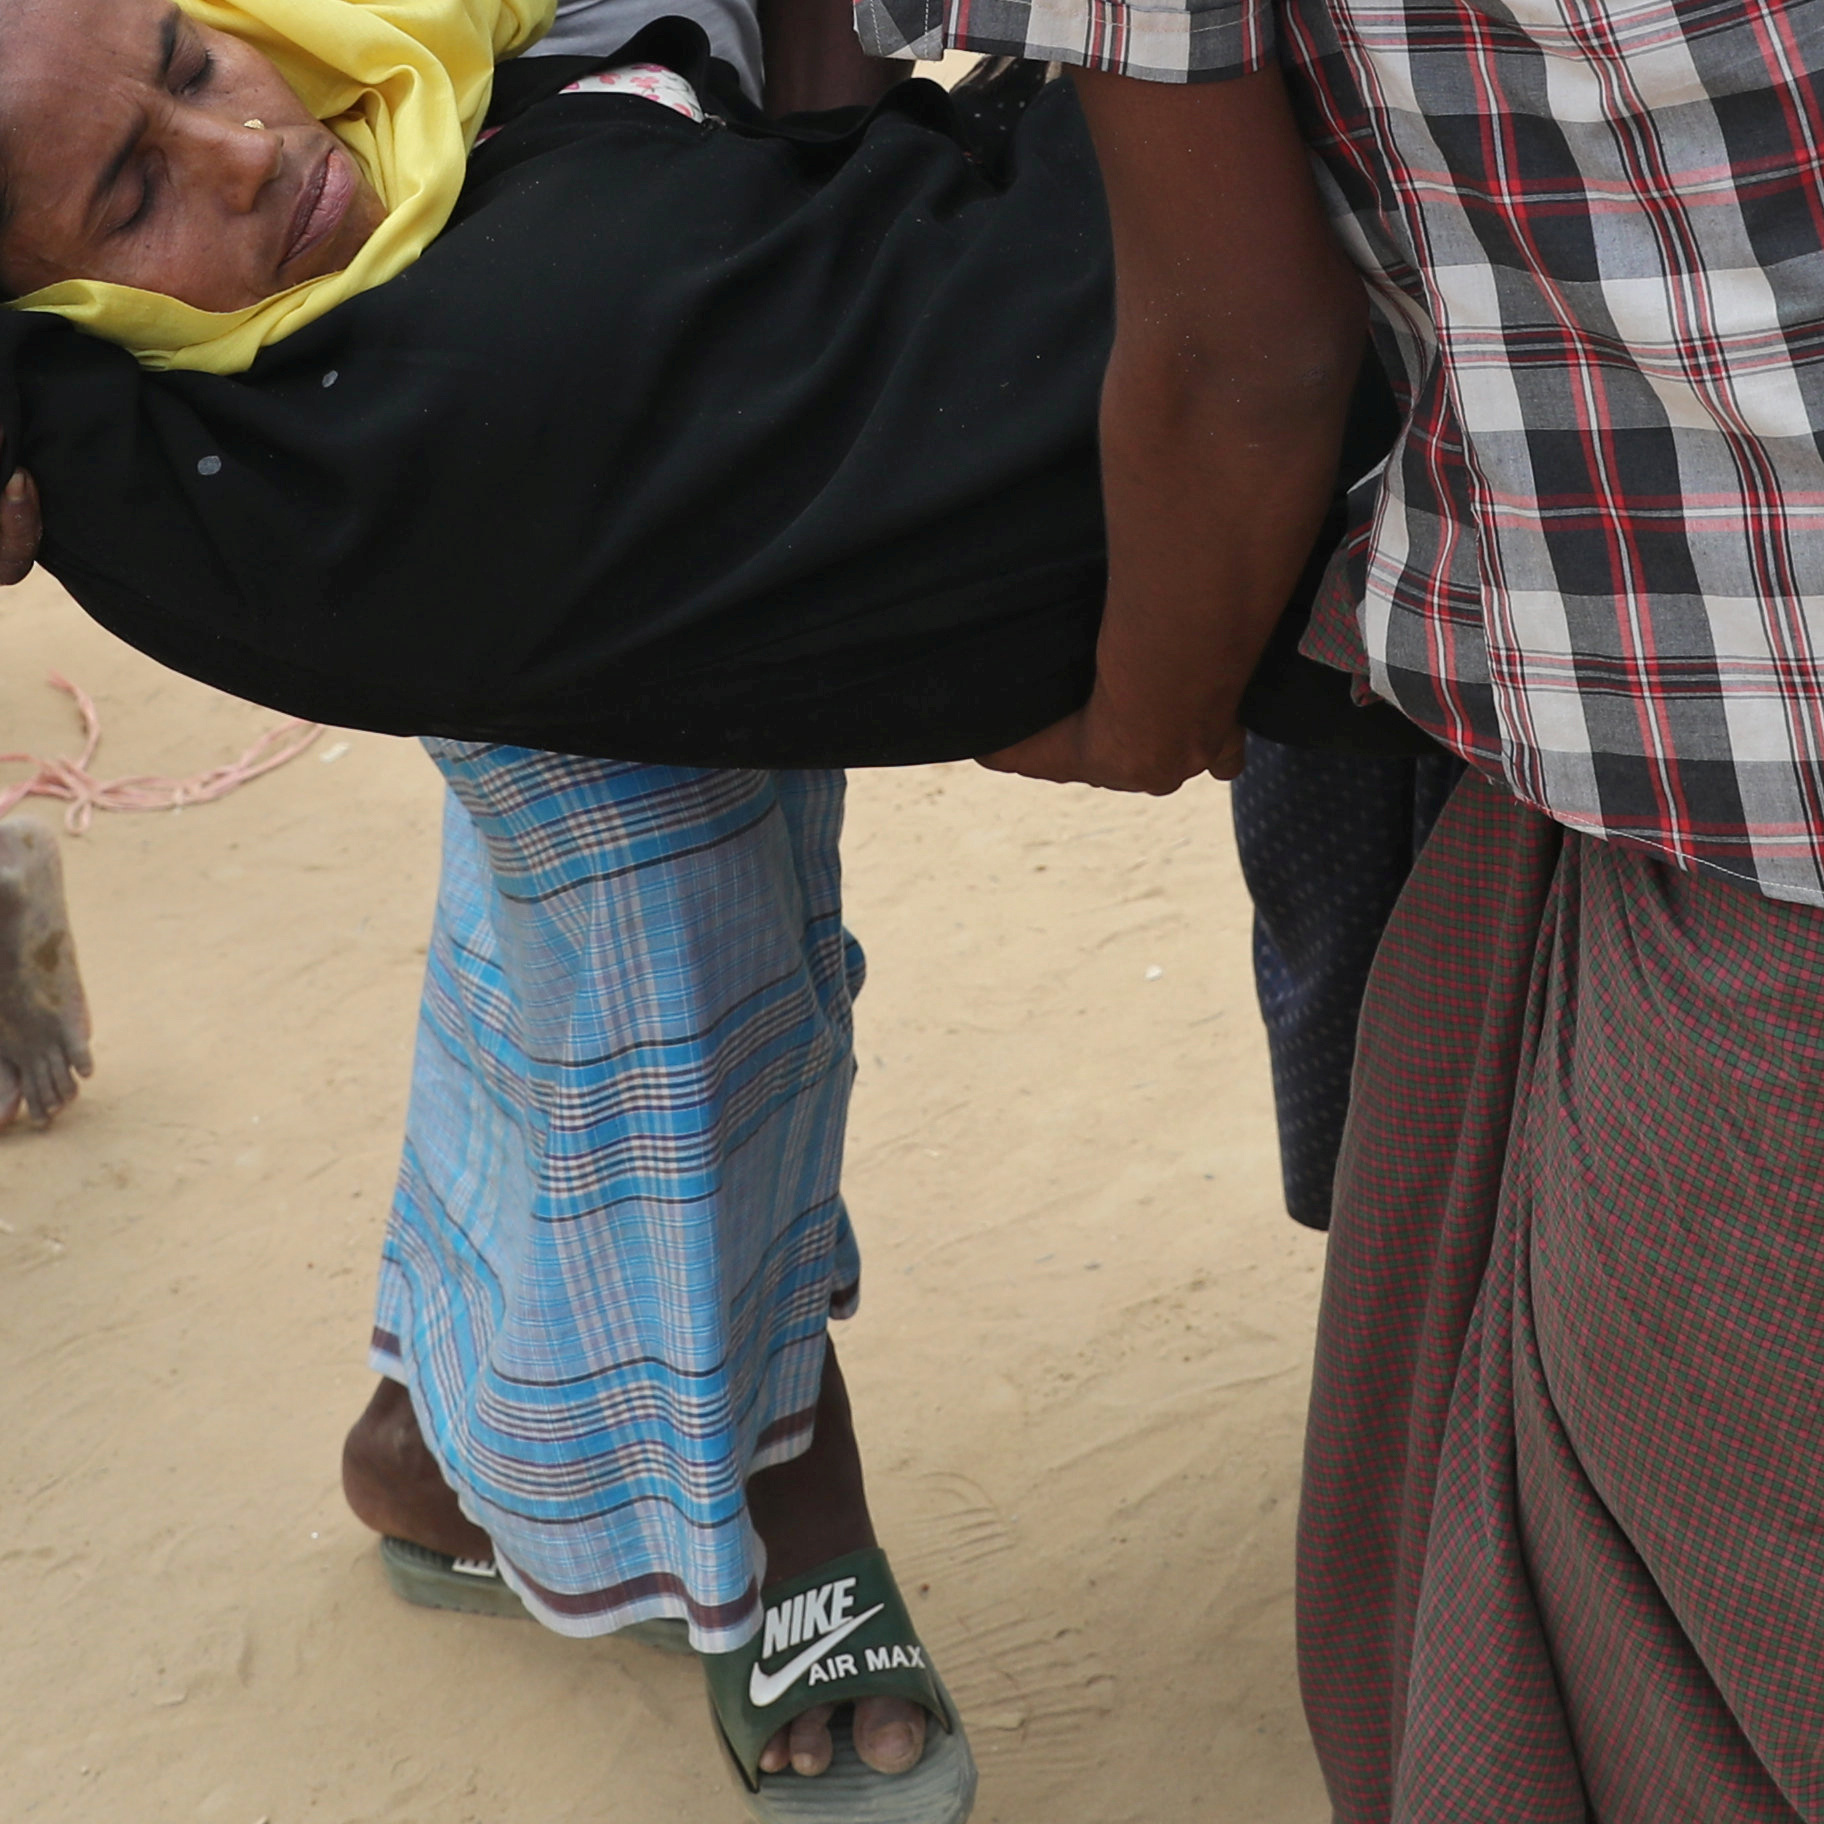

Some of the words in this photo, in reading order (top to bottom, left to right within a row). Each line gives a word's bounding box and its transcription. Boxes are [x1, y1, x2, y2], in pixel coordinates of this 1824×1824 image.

[762, 1576, 857, 1660] NIKE
[808, 1653, 858, 1686] AIR
[864, 1644, 925, 1672] MAX
